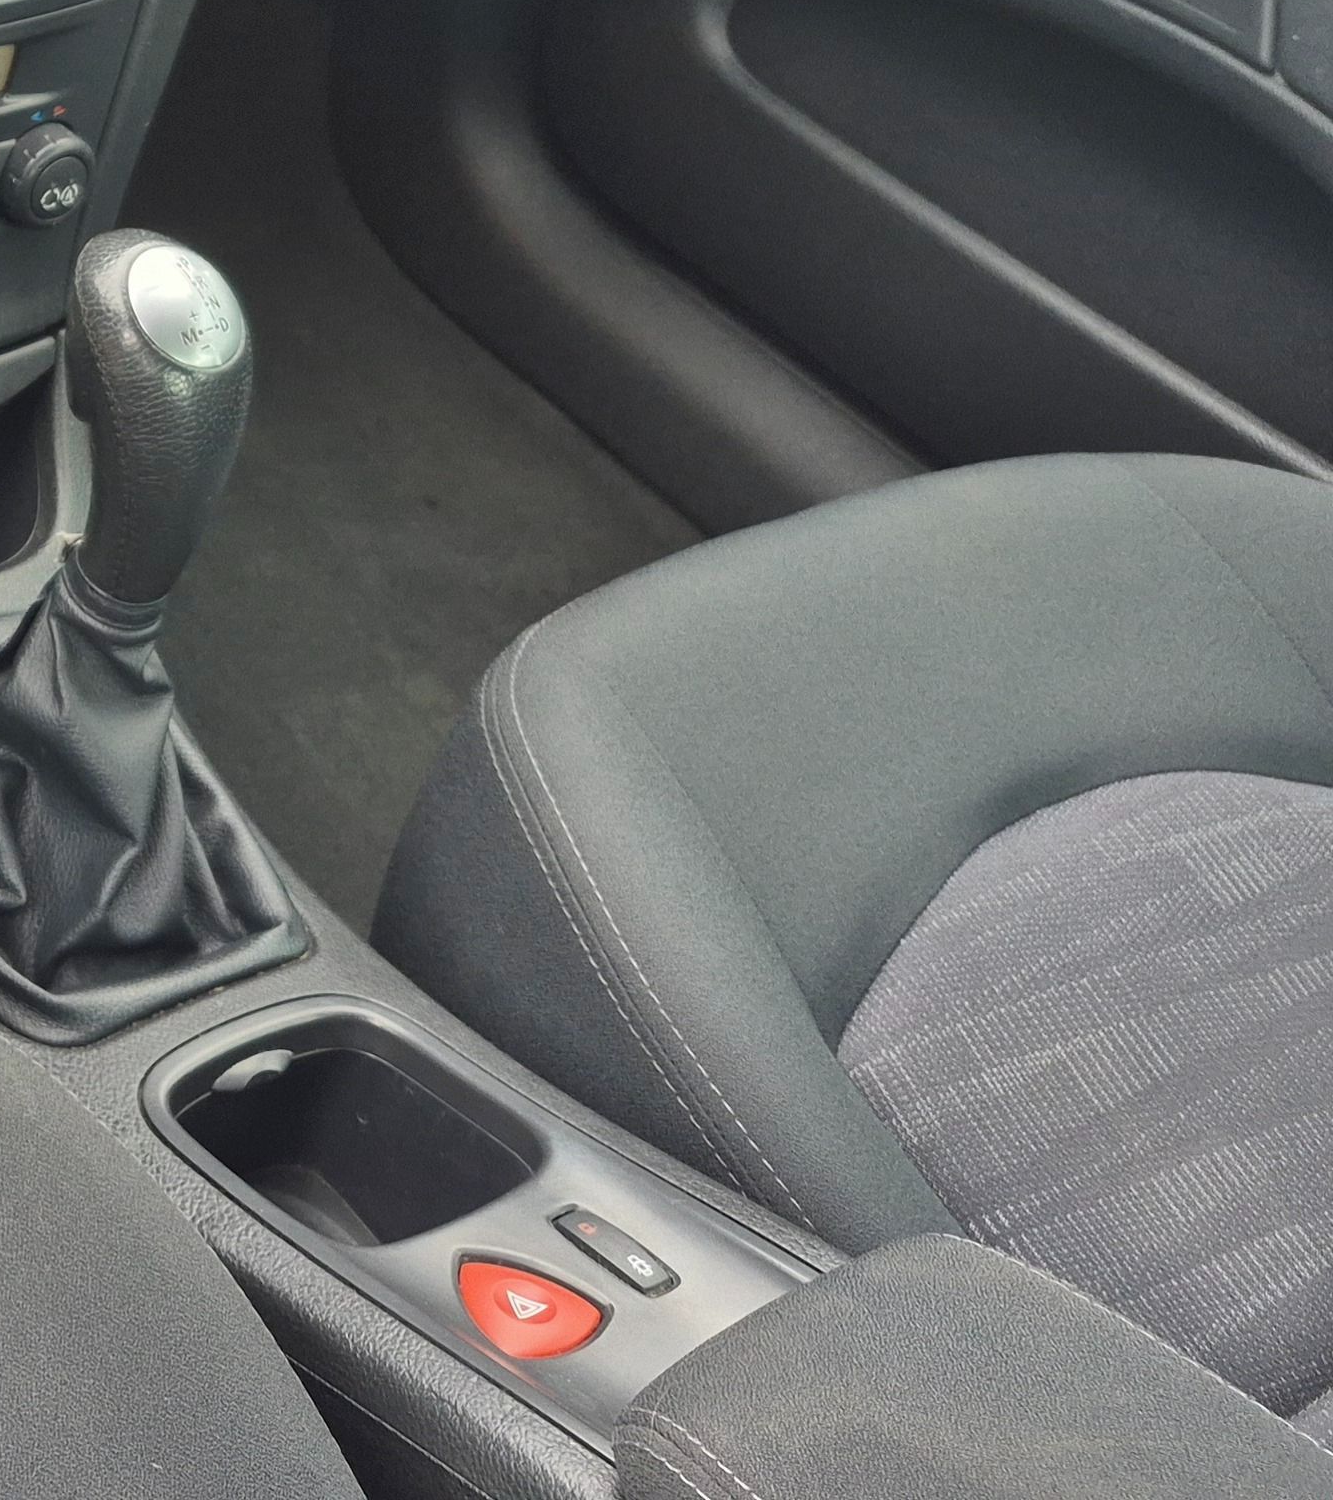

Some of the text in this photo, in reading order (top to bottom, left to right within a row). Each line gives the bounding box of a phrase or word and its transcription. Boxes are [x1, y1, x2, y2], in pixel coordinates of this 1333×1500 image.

[207, 294, 222, 311] N
[219, 316, 230, 333] D
[180, 327, 200, 347] M
